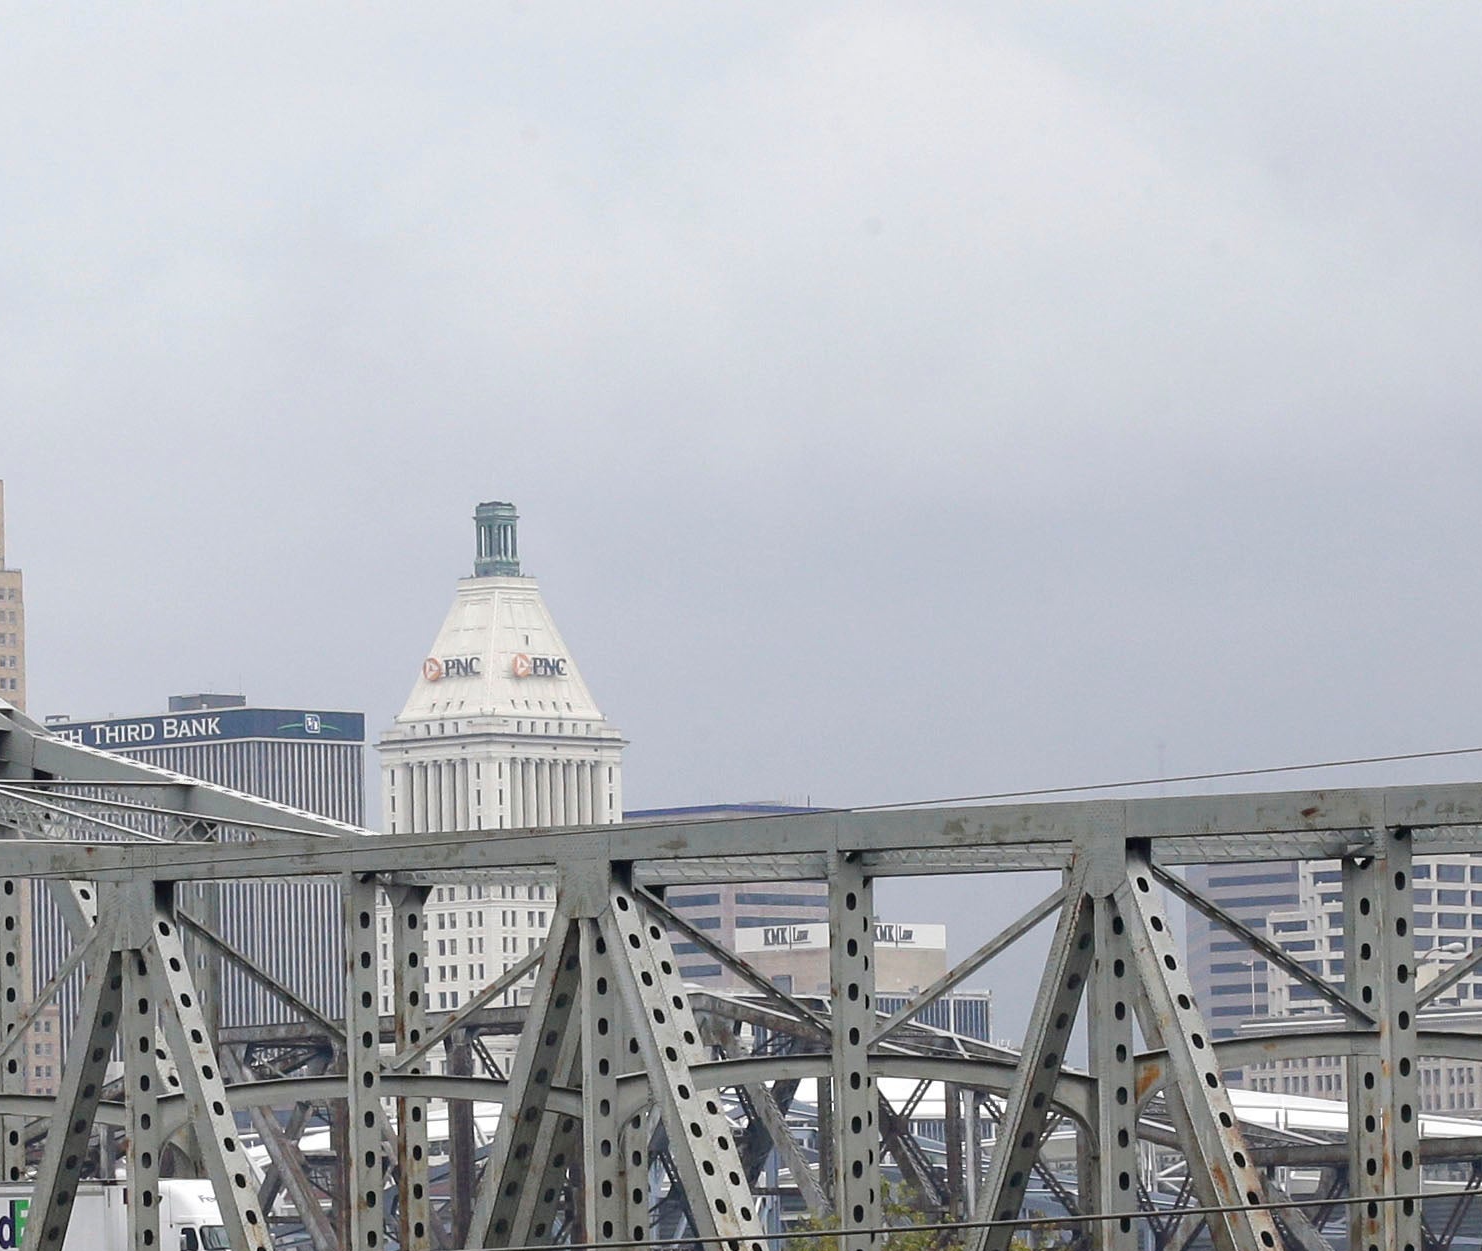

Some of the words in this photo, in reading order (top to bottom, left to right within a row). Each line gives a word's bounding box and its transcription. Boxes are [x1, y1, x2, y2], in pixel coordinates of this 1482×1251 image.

[443, 656, 481, 677] PNC
[533, 656, 568, 677] PNC
[90, 723, 155, 745] THIRD
[162, 716, 222, 739] BANK
